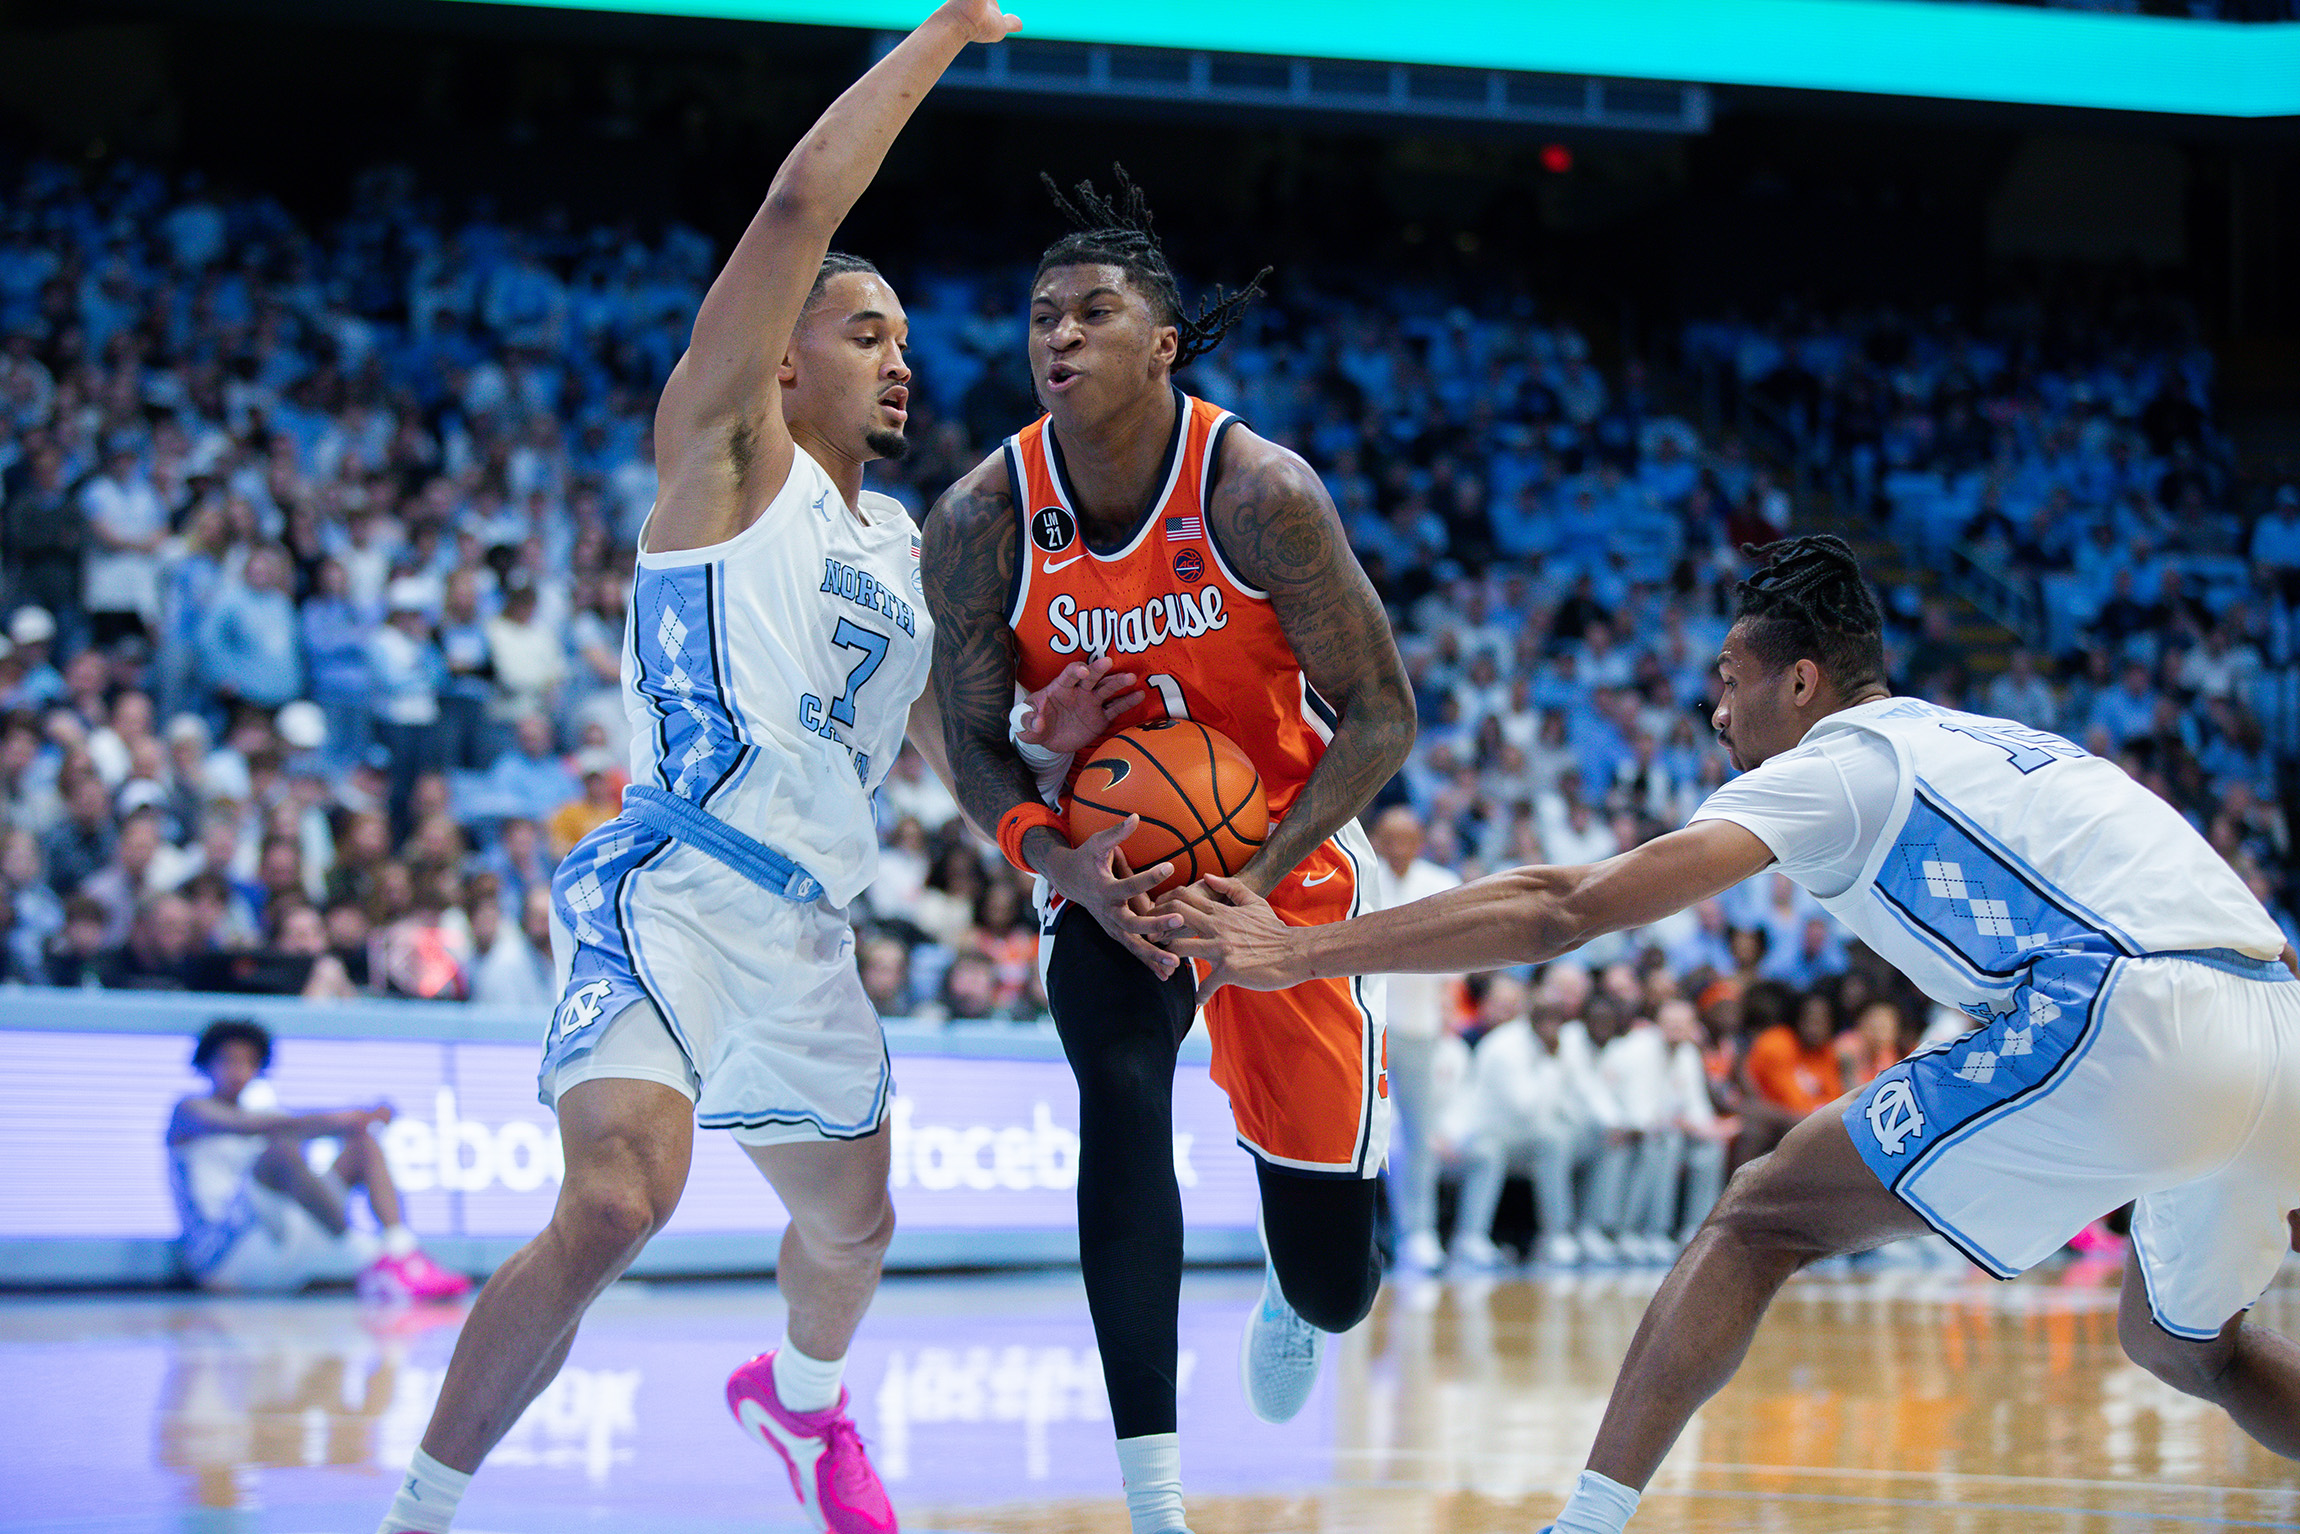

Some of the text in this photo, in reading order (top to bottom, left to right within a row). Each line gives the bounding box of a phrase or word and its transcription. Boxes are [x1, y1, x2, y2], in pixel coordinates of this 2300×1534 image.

[1042, 511, 1059, 527] LM
[1045, 525, 1063, 548] 21
[1178, 559, 1200, 568] ACC
[820, 558, 916, 639] NORTH
[1048, 584, 1229, 666] Syracuse
[831, 615, 891, 729] 7
[1146, 673, 1193, 721] 1
